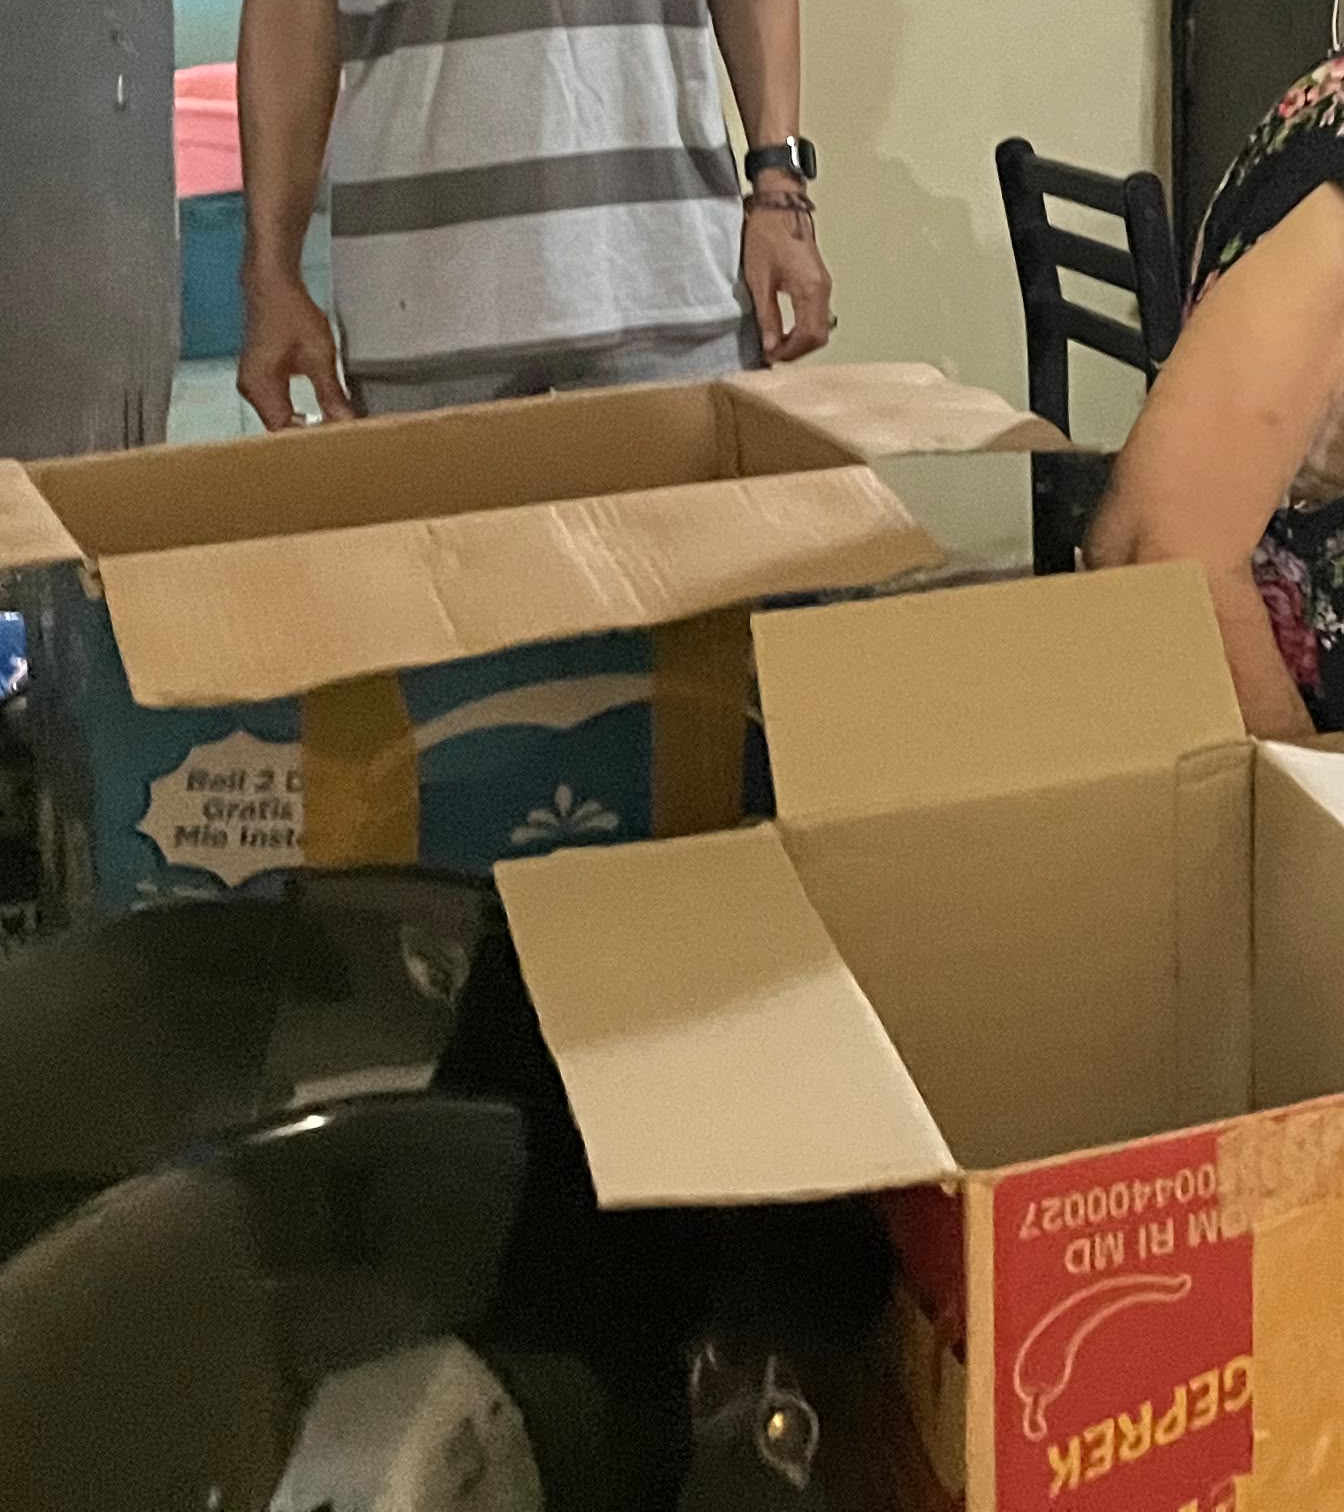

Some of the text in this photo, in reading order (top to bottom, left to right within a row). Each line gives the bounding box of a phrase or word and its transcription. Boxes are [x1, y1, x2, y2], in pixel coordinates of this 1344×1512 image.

[202, 797, 294, 821] Gratis
[1018, 1163, 1217, 1240] 004400027
[1064, 1231, 1125, 1274] MD
[1138, 1217, 1175, 1261] RI
[1047, 1354, 1253, 1500] GEPREK
